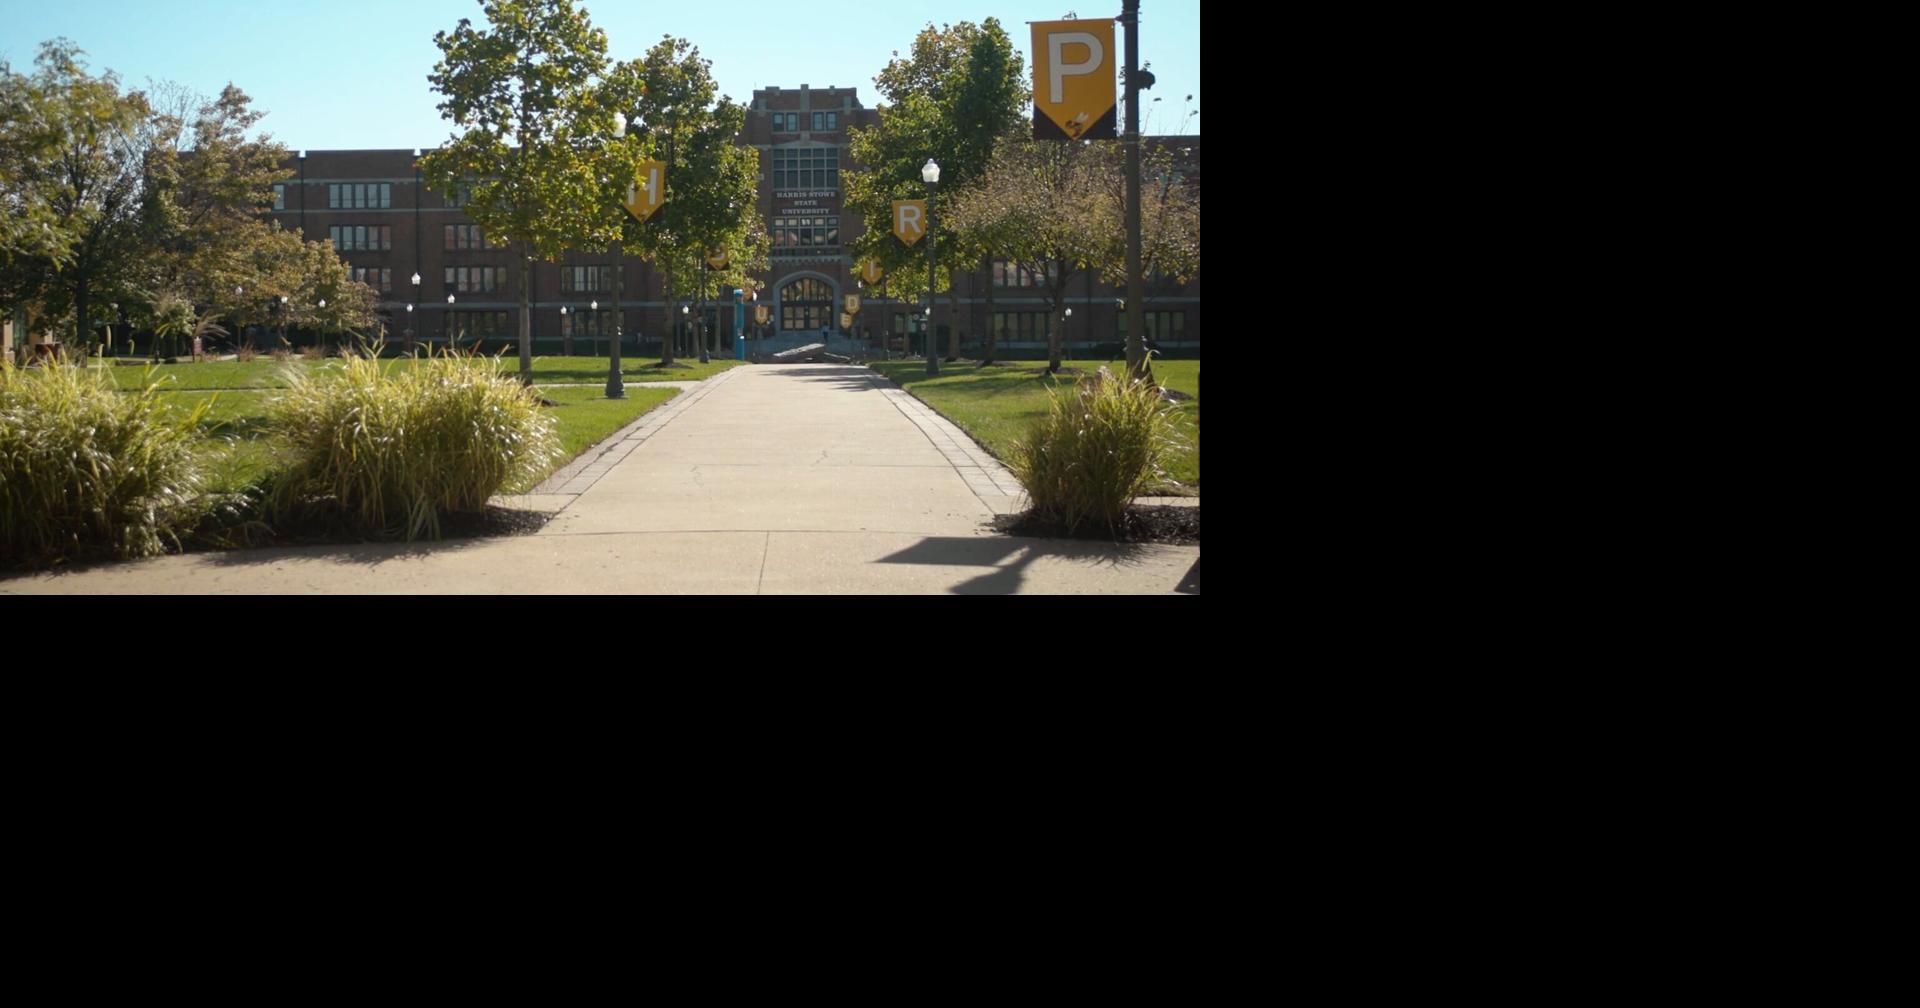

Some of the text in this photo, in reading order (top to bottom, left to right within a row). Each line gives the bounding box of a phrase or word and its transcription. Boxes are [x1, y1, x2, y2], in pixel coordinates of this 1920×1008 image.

[1047, 32, 1104, 104] P
[628, 167, 657, 205] H
[899, 205, 921, 233] R
